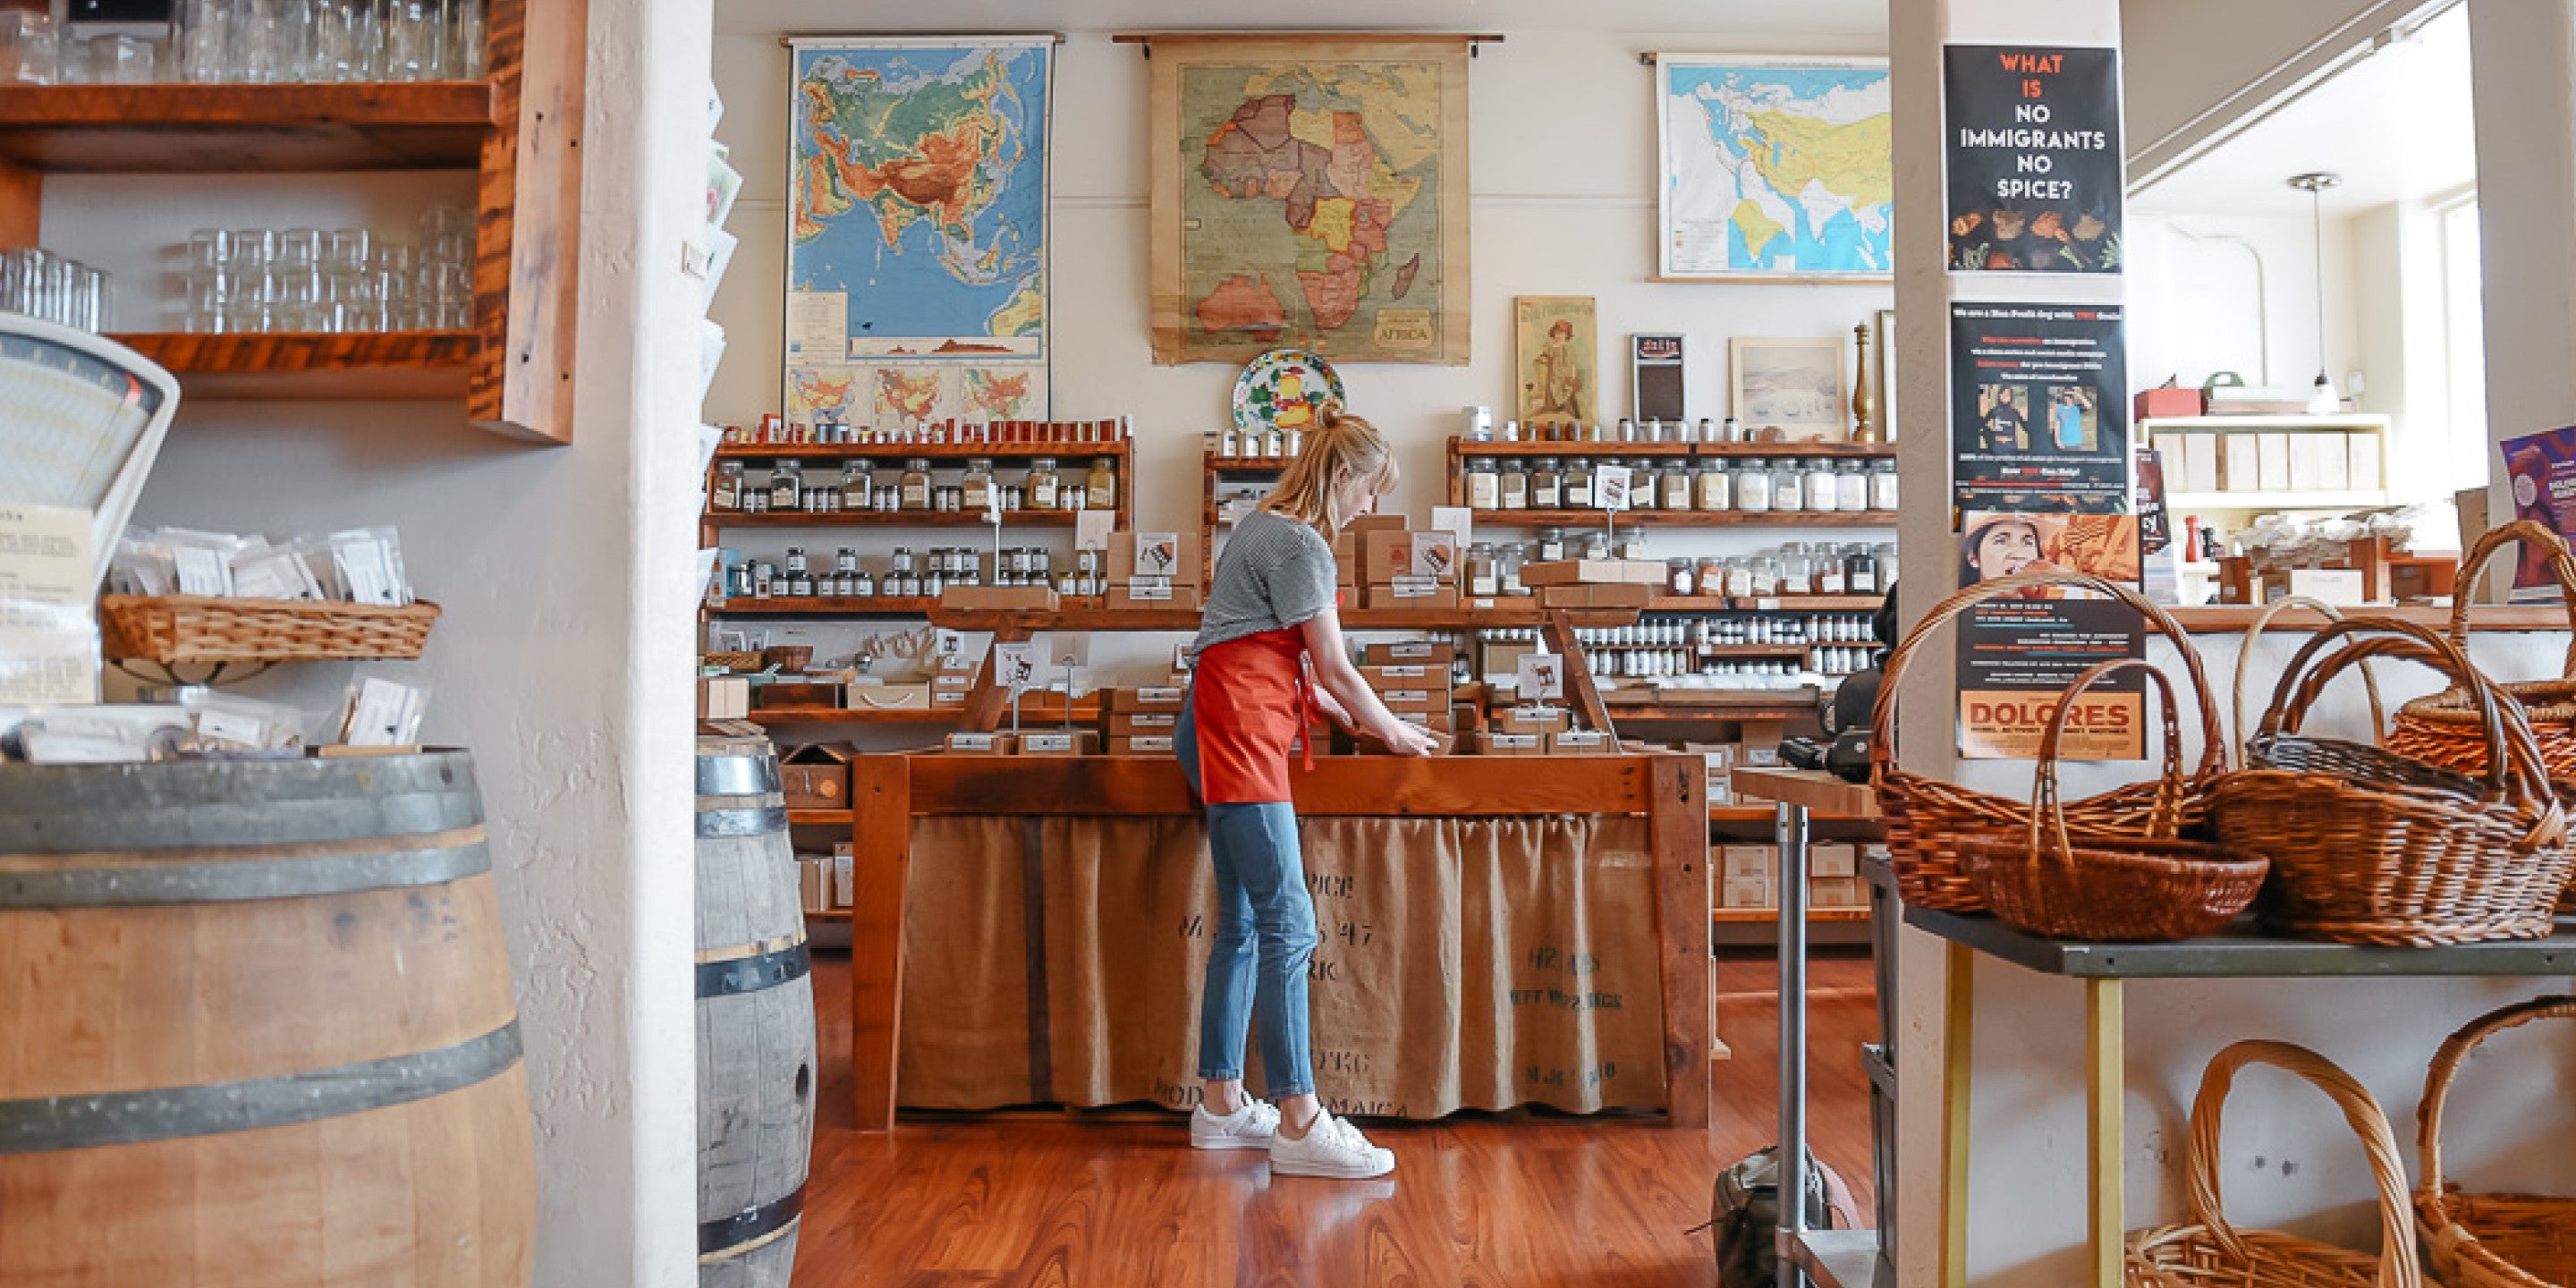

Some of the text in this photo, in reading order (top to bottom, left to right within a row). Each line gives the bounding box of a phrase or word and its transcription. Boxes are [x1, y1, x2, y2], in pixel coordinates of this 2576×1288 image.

[2000, 54, 2063, 73] WHAT
[2022, 79, 2043, 98] IS
[2014, 104, 2051, 123] NO
[1960, 127, 2106, 150] IMMIGRANTS
[2016, 153, 2054, 174] NO
[1997, 179, 2072, 199] SPICE?
[1970, 702, 2130, 726] DOLORES
